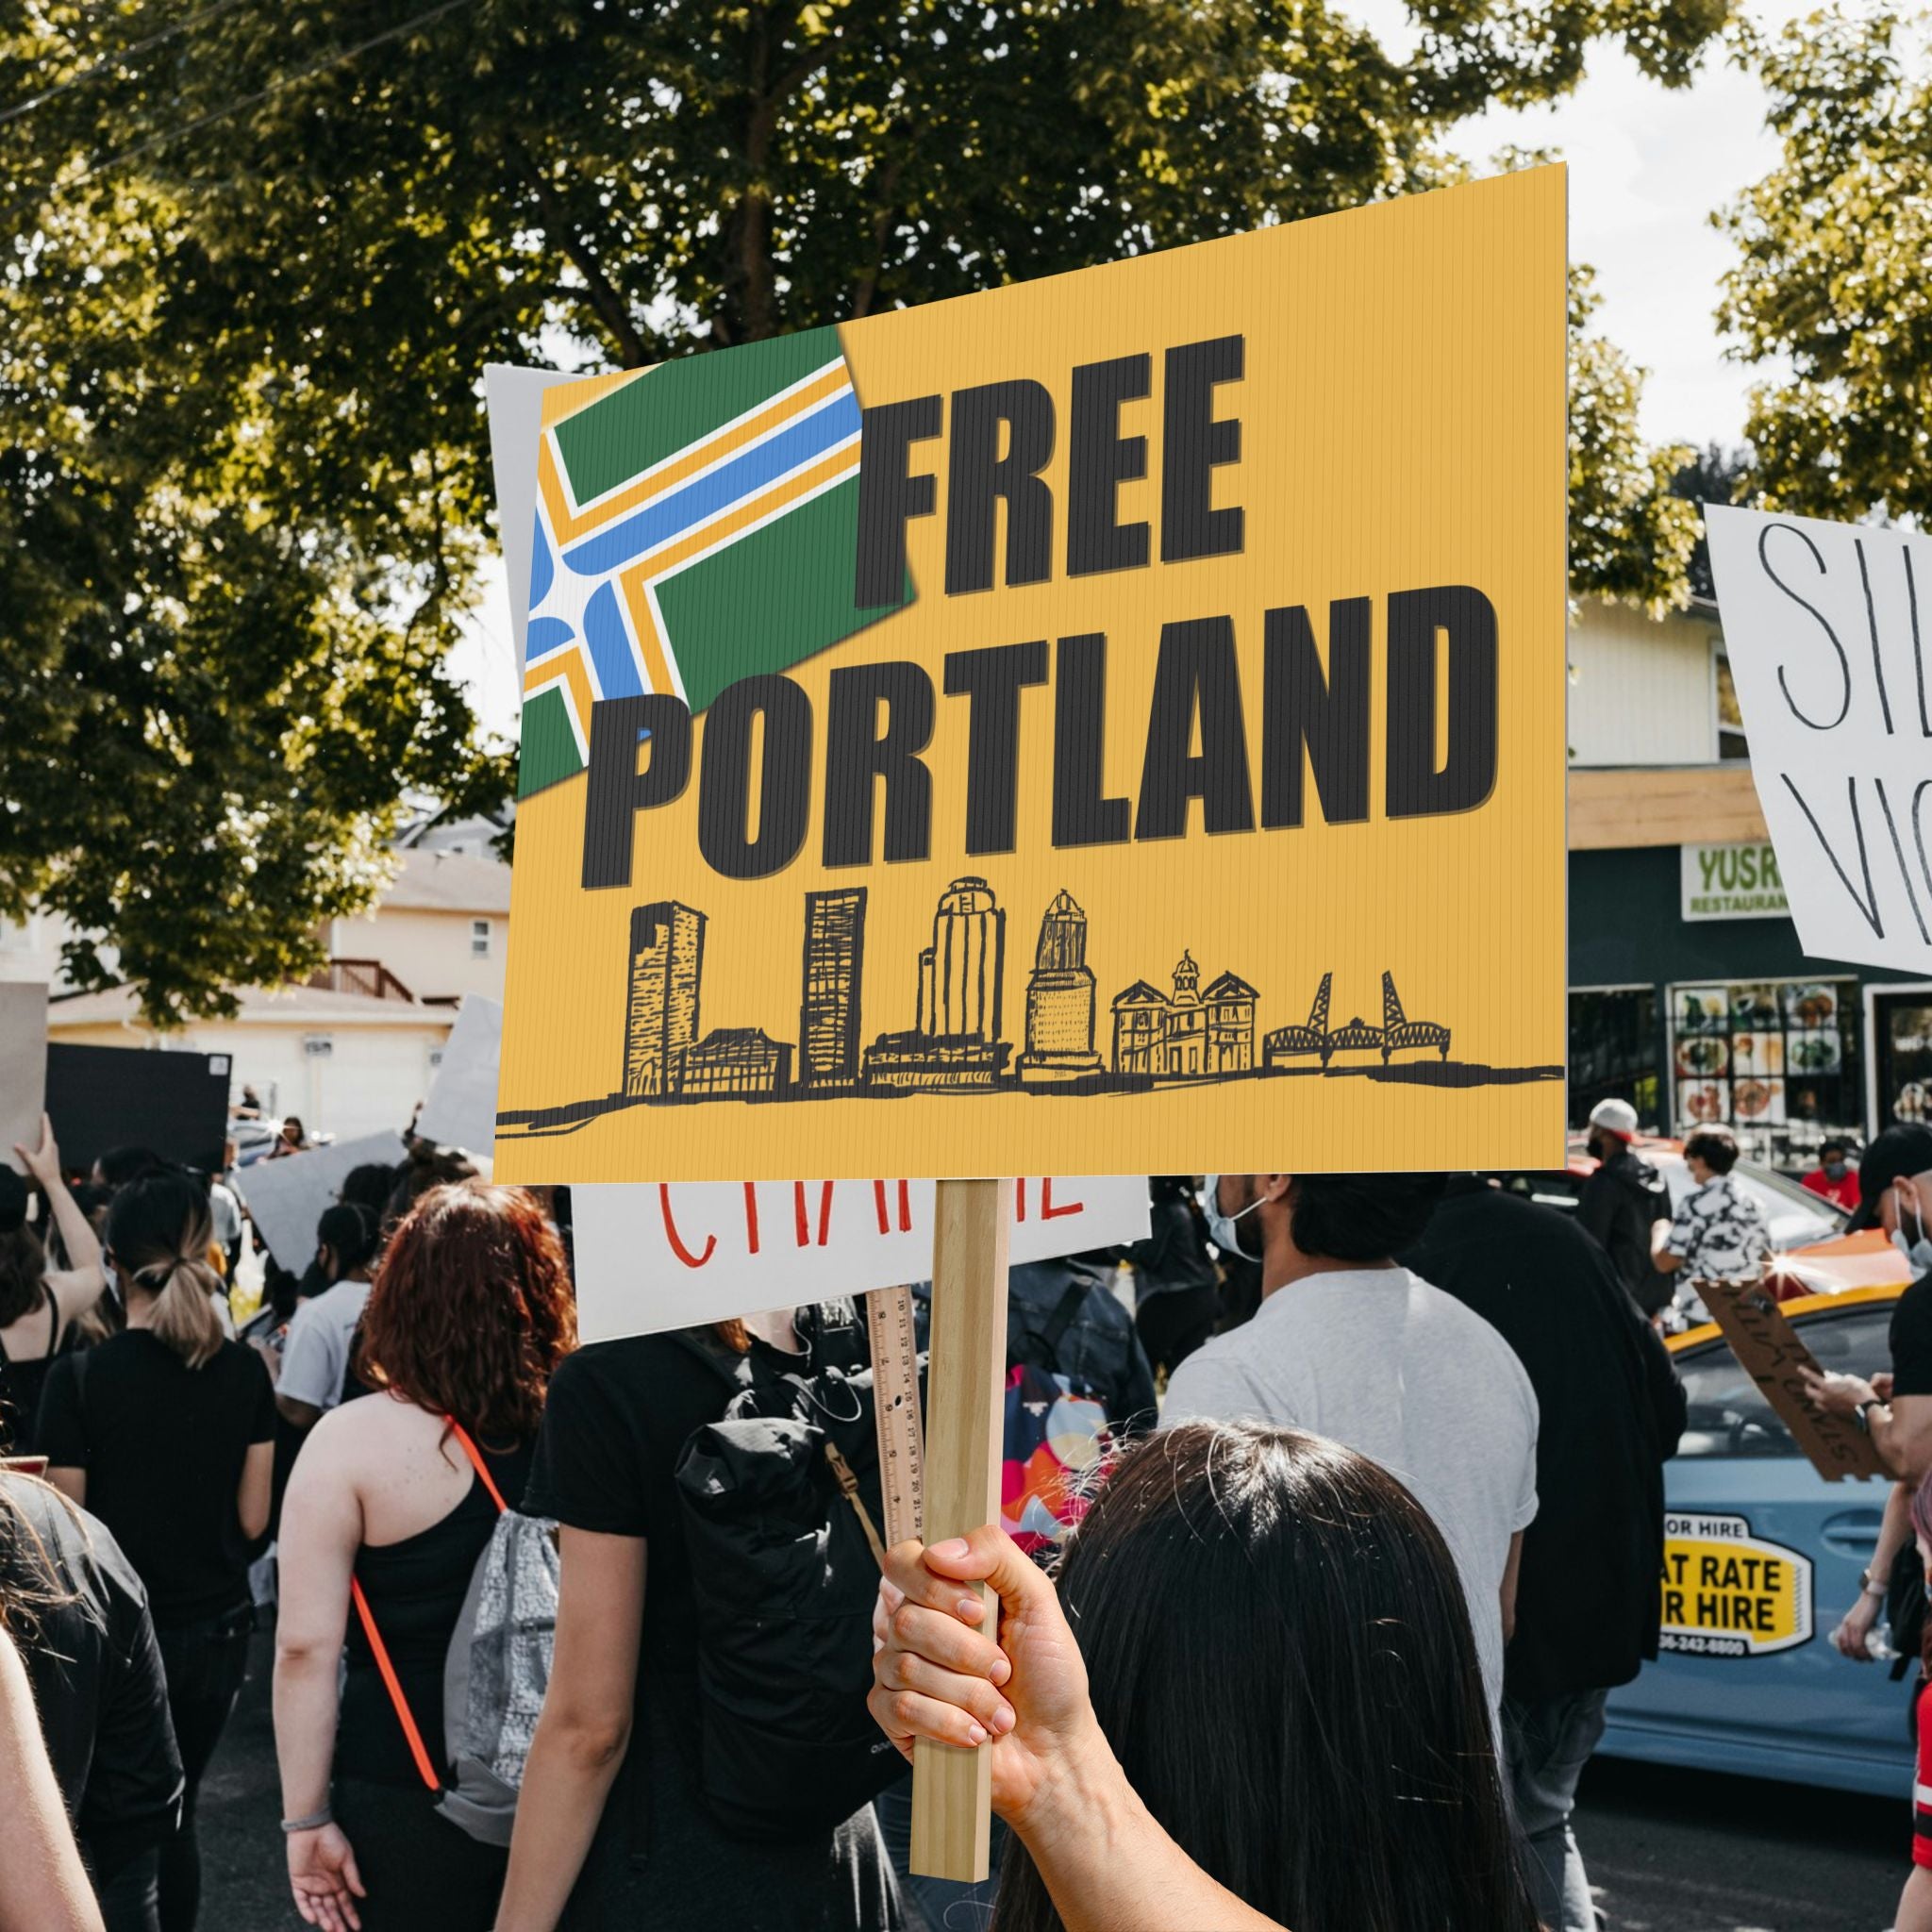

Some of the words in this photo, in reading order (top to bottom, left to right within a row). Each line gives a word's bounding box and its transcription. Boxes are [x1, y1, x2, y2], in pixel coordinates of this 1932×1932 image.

[855, 334, 1244, 610] FREE
[581, 585, 1498, 890] PORTLAND
[898, 1300, 906, 1311] 10
[878, 1311, 886, 1320] 8
[899, 1318, 907, 1329] 11
[900, 1337, 908, 1347] 12
[881, 1358, 890, 1367] 7
[902, 1355, 909, 1366] 13
[903, 1373, 910, 1384] 14
[905, 1391, 912, 1402] 15
[885, 1404, 893, 1412] 6
[907, 1408, 914, 1421] 16
[908, 1427, 916, 1438] 17
[889, 1449, 897, 1457] 5
[908, 1445, 917, 1457] 18
[910, 1463, 919, 1474] 19
[911, 1480, 920, 1492] 20
[893, 1495, 901, 1504] 4
[913, 1498, 921, 1509] 21
[914, 1516, 923, 1528] 22
[1699, 1522, 1743, 1539] HIRE
[1701, 1556, 1781, 1592] RATE
[1698, 1592, 1775, 1632] HIRE
